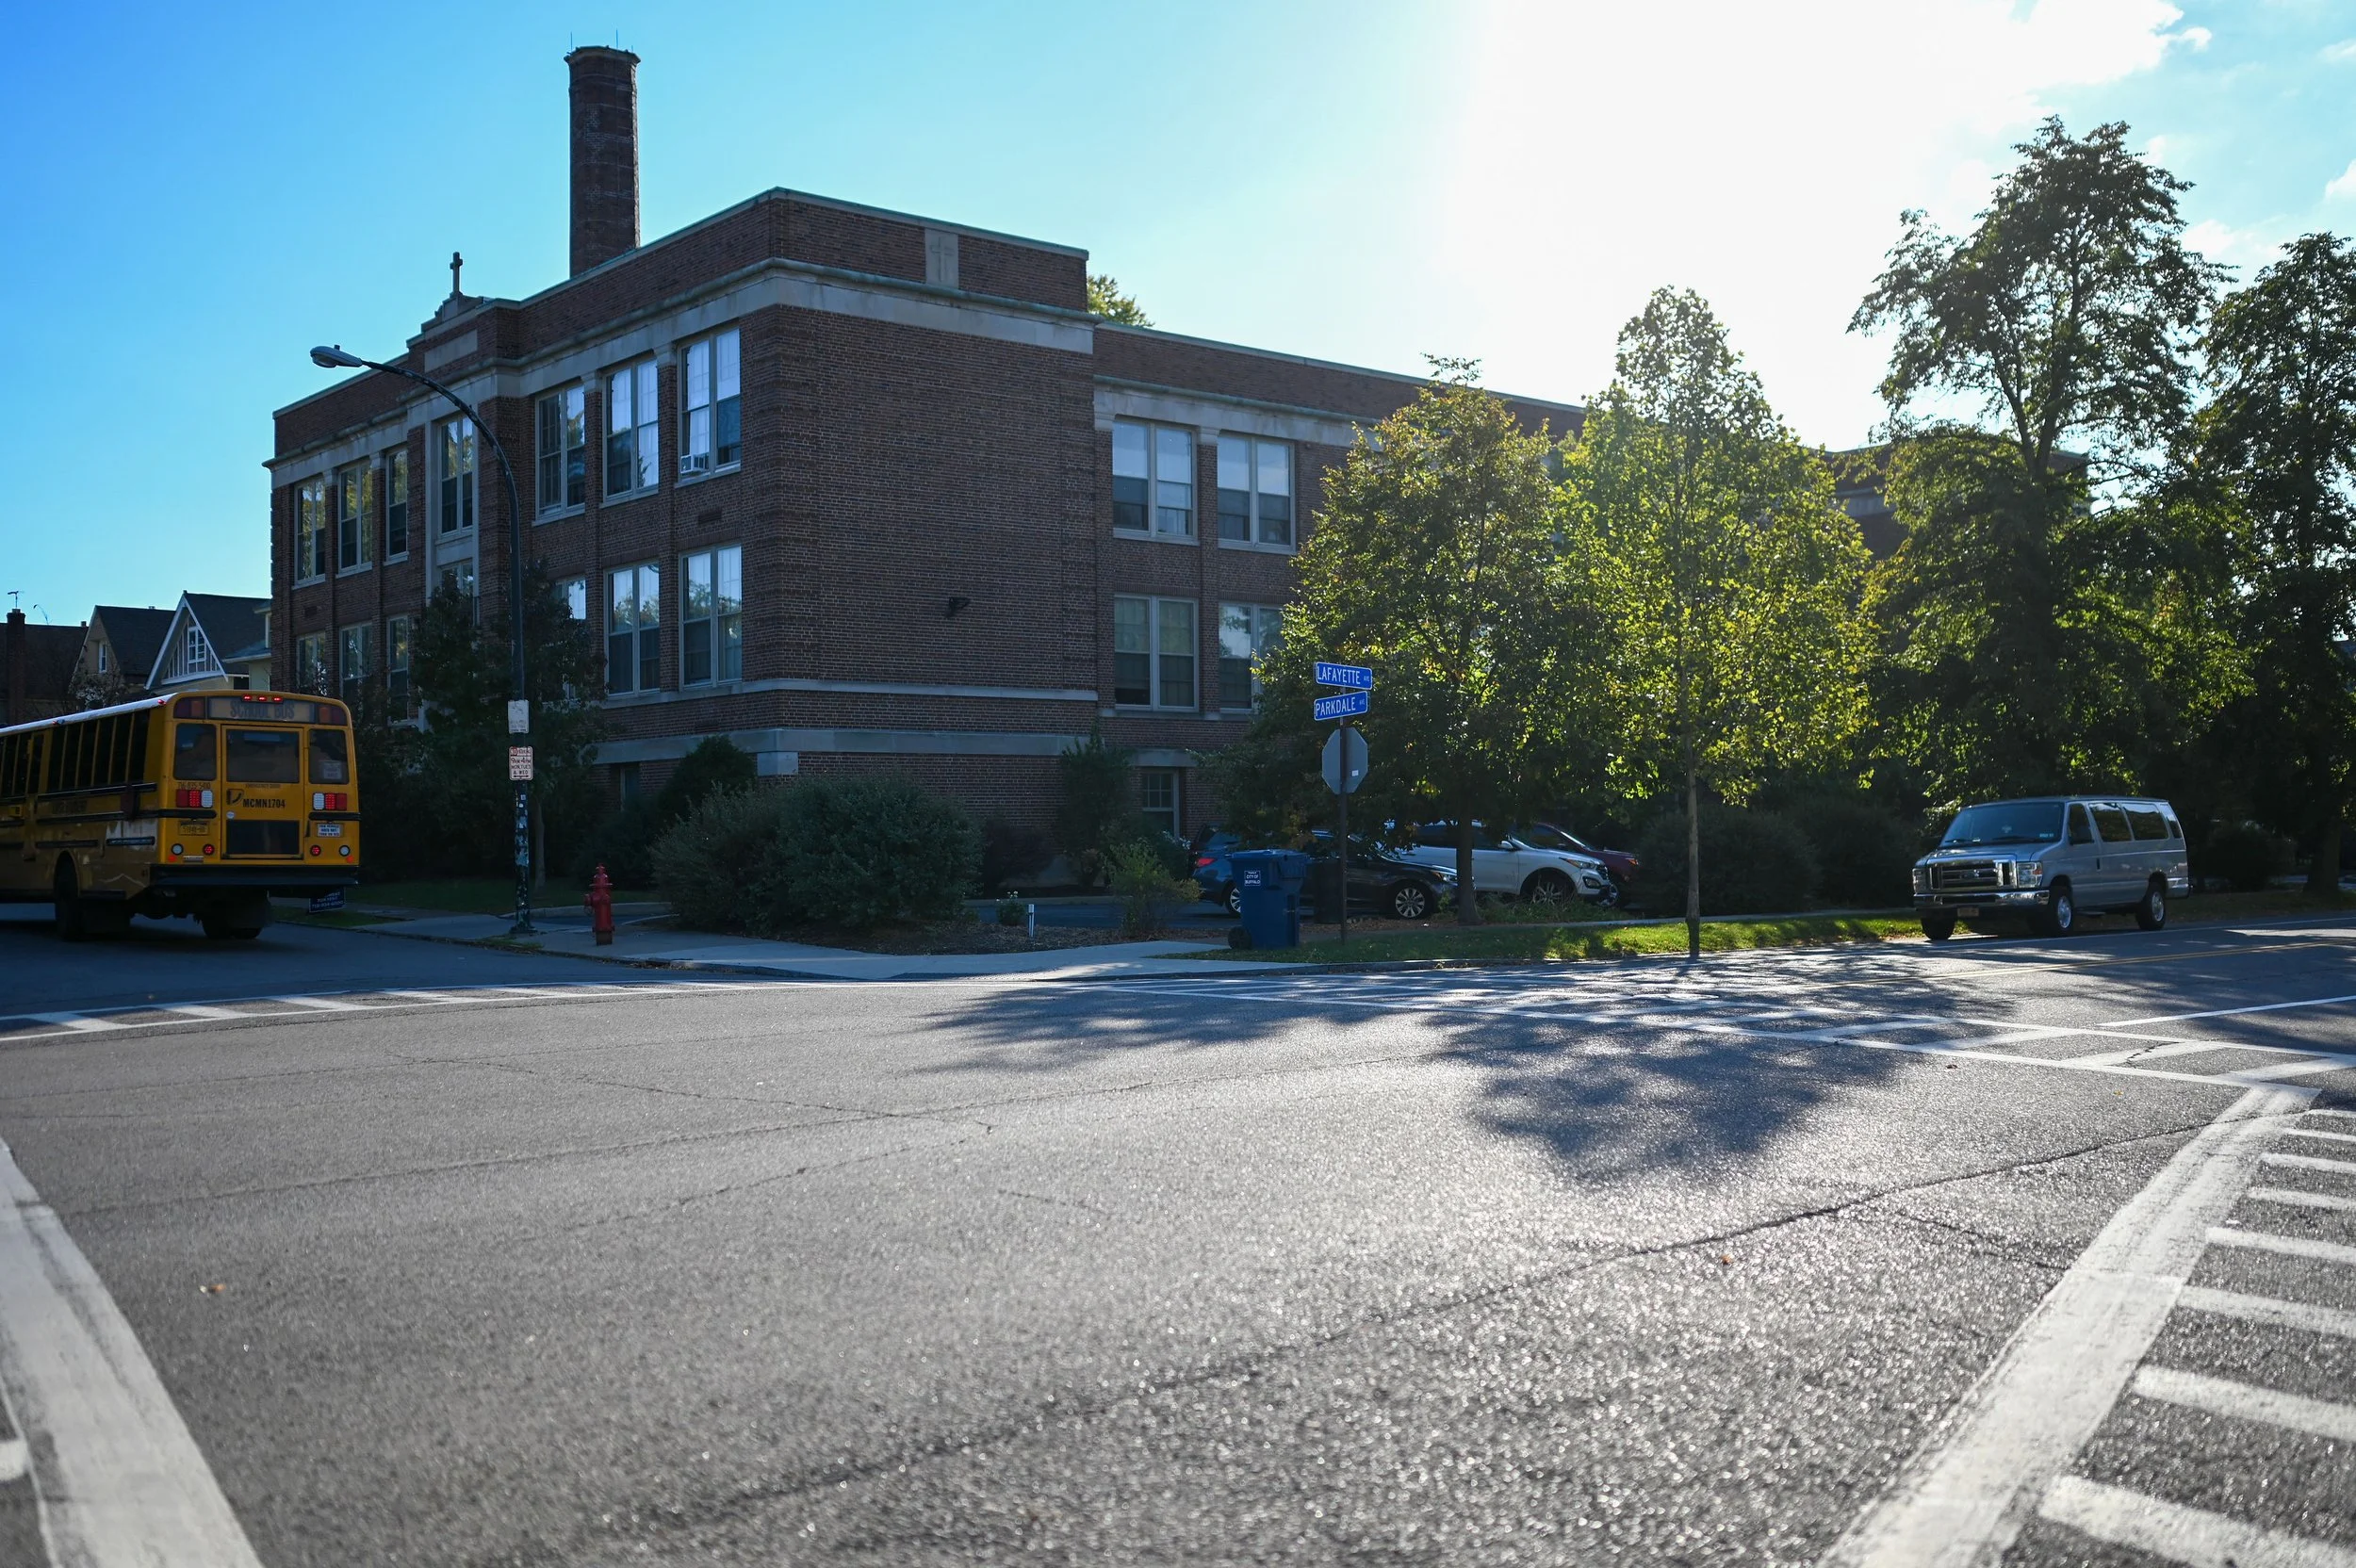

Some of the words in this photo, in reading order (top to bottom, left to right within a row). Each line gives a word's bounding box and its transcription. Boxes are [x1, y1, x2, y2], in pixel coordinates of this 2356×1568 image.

[1317, 666, 1361, 684] LAFAYETTE
[230, 699, 271, 718] SCHOOL
[274, 700, 295, 720] BUS
[1316, 697, 1356, 717] PARKDALE
[242, 798, 286, 808] MCMN1704
